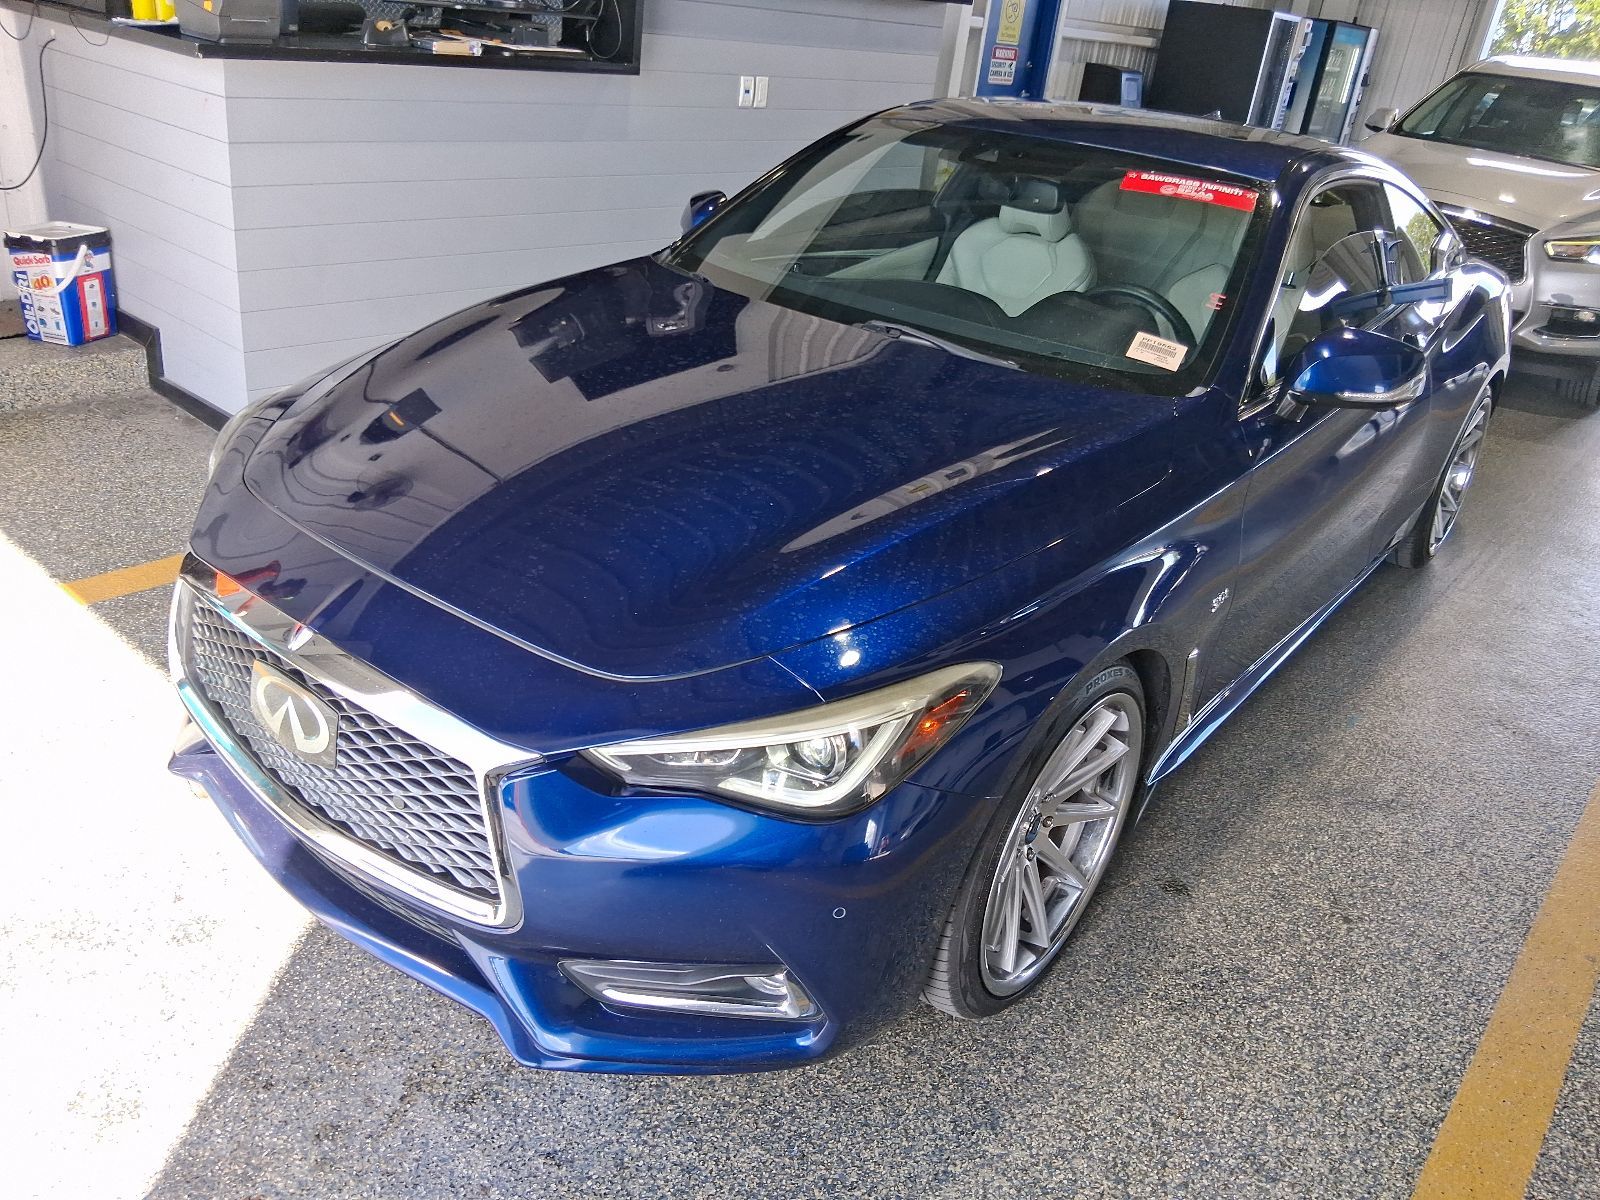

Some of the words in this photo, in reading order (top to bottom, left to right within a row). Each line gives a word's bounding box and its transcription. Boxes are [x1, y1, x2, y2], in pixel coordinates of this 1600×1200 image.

[13, 256, 33, 266] Quick
[33, 255, 51, 265] Sorb
[1085, 668, 1123, 695] PROXES
